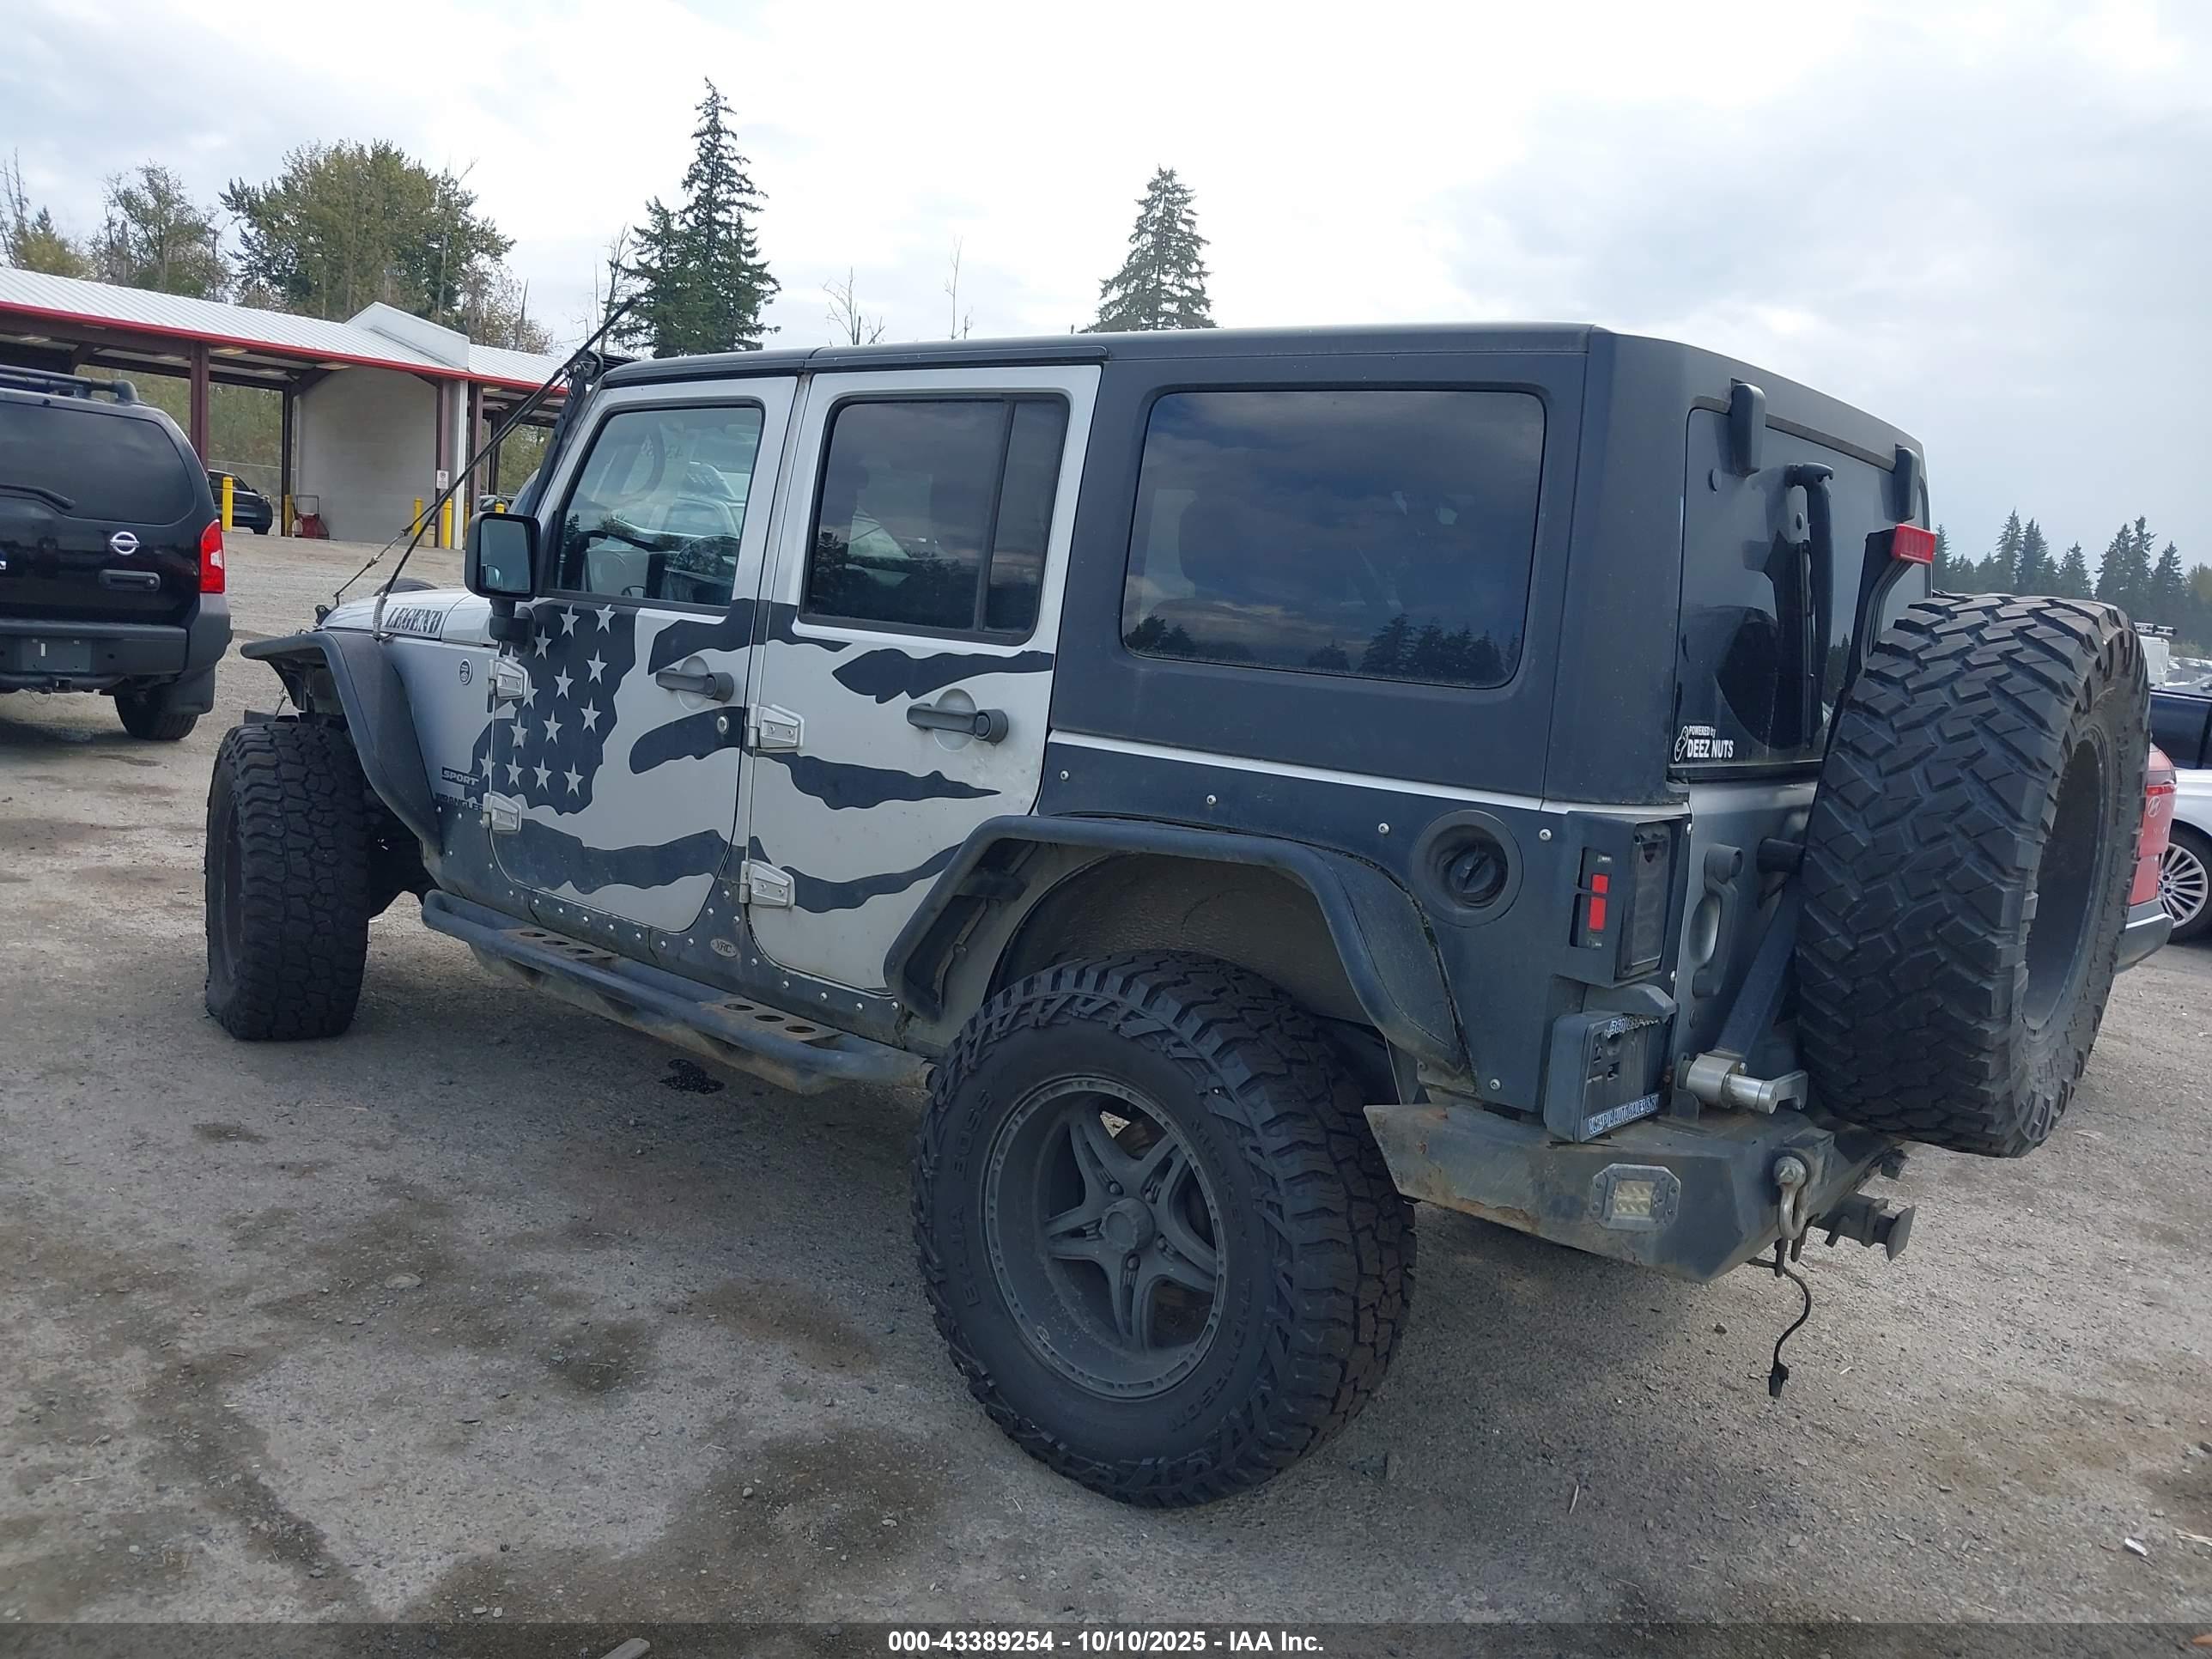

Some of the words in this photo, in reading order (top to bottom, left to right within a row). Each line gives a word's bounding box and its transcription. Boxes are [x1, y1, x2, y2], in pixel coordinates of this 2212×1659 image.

[385, 606, 443, 634] LEGEND
[1688, 725, 1710, 737] POWERED
[1686, 738, 1710, 758] DEEZ
[1711, 739, 1735, 759] NUTS
[442, 769, 480, 787] SPORT
[1628, 1098, 1646, 1120] SALES
